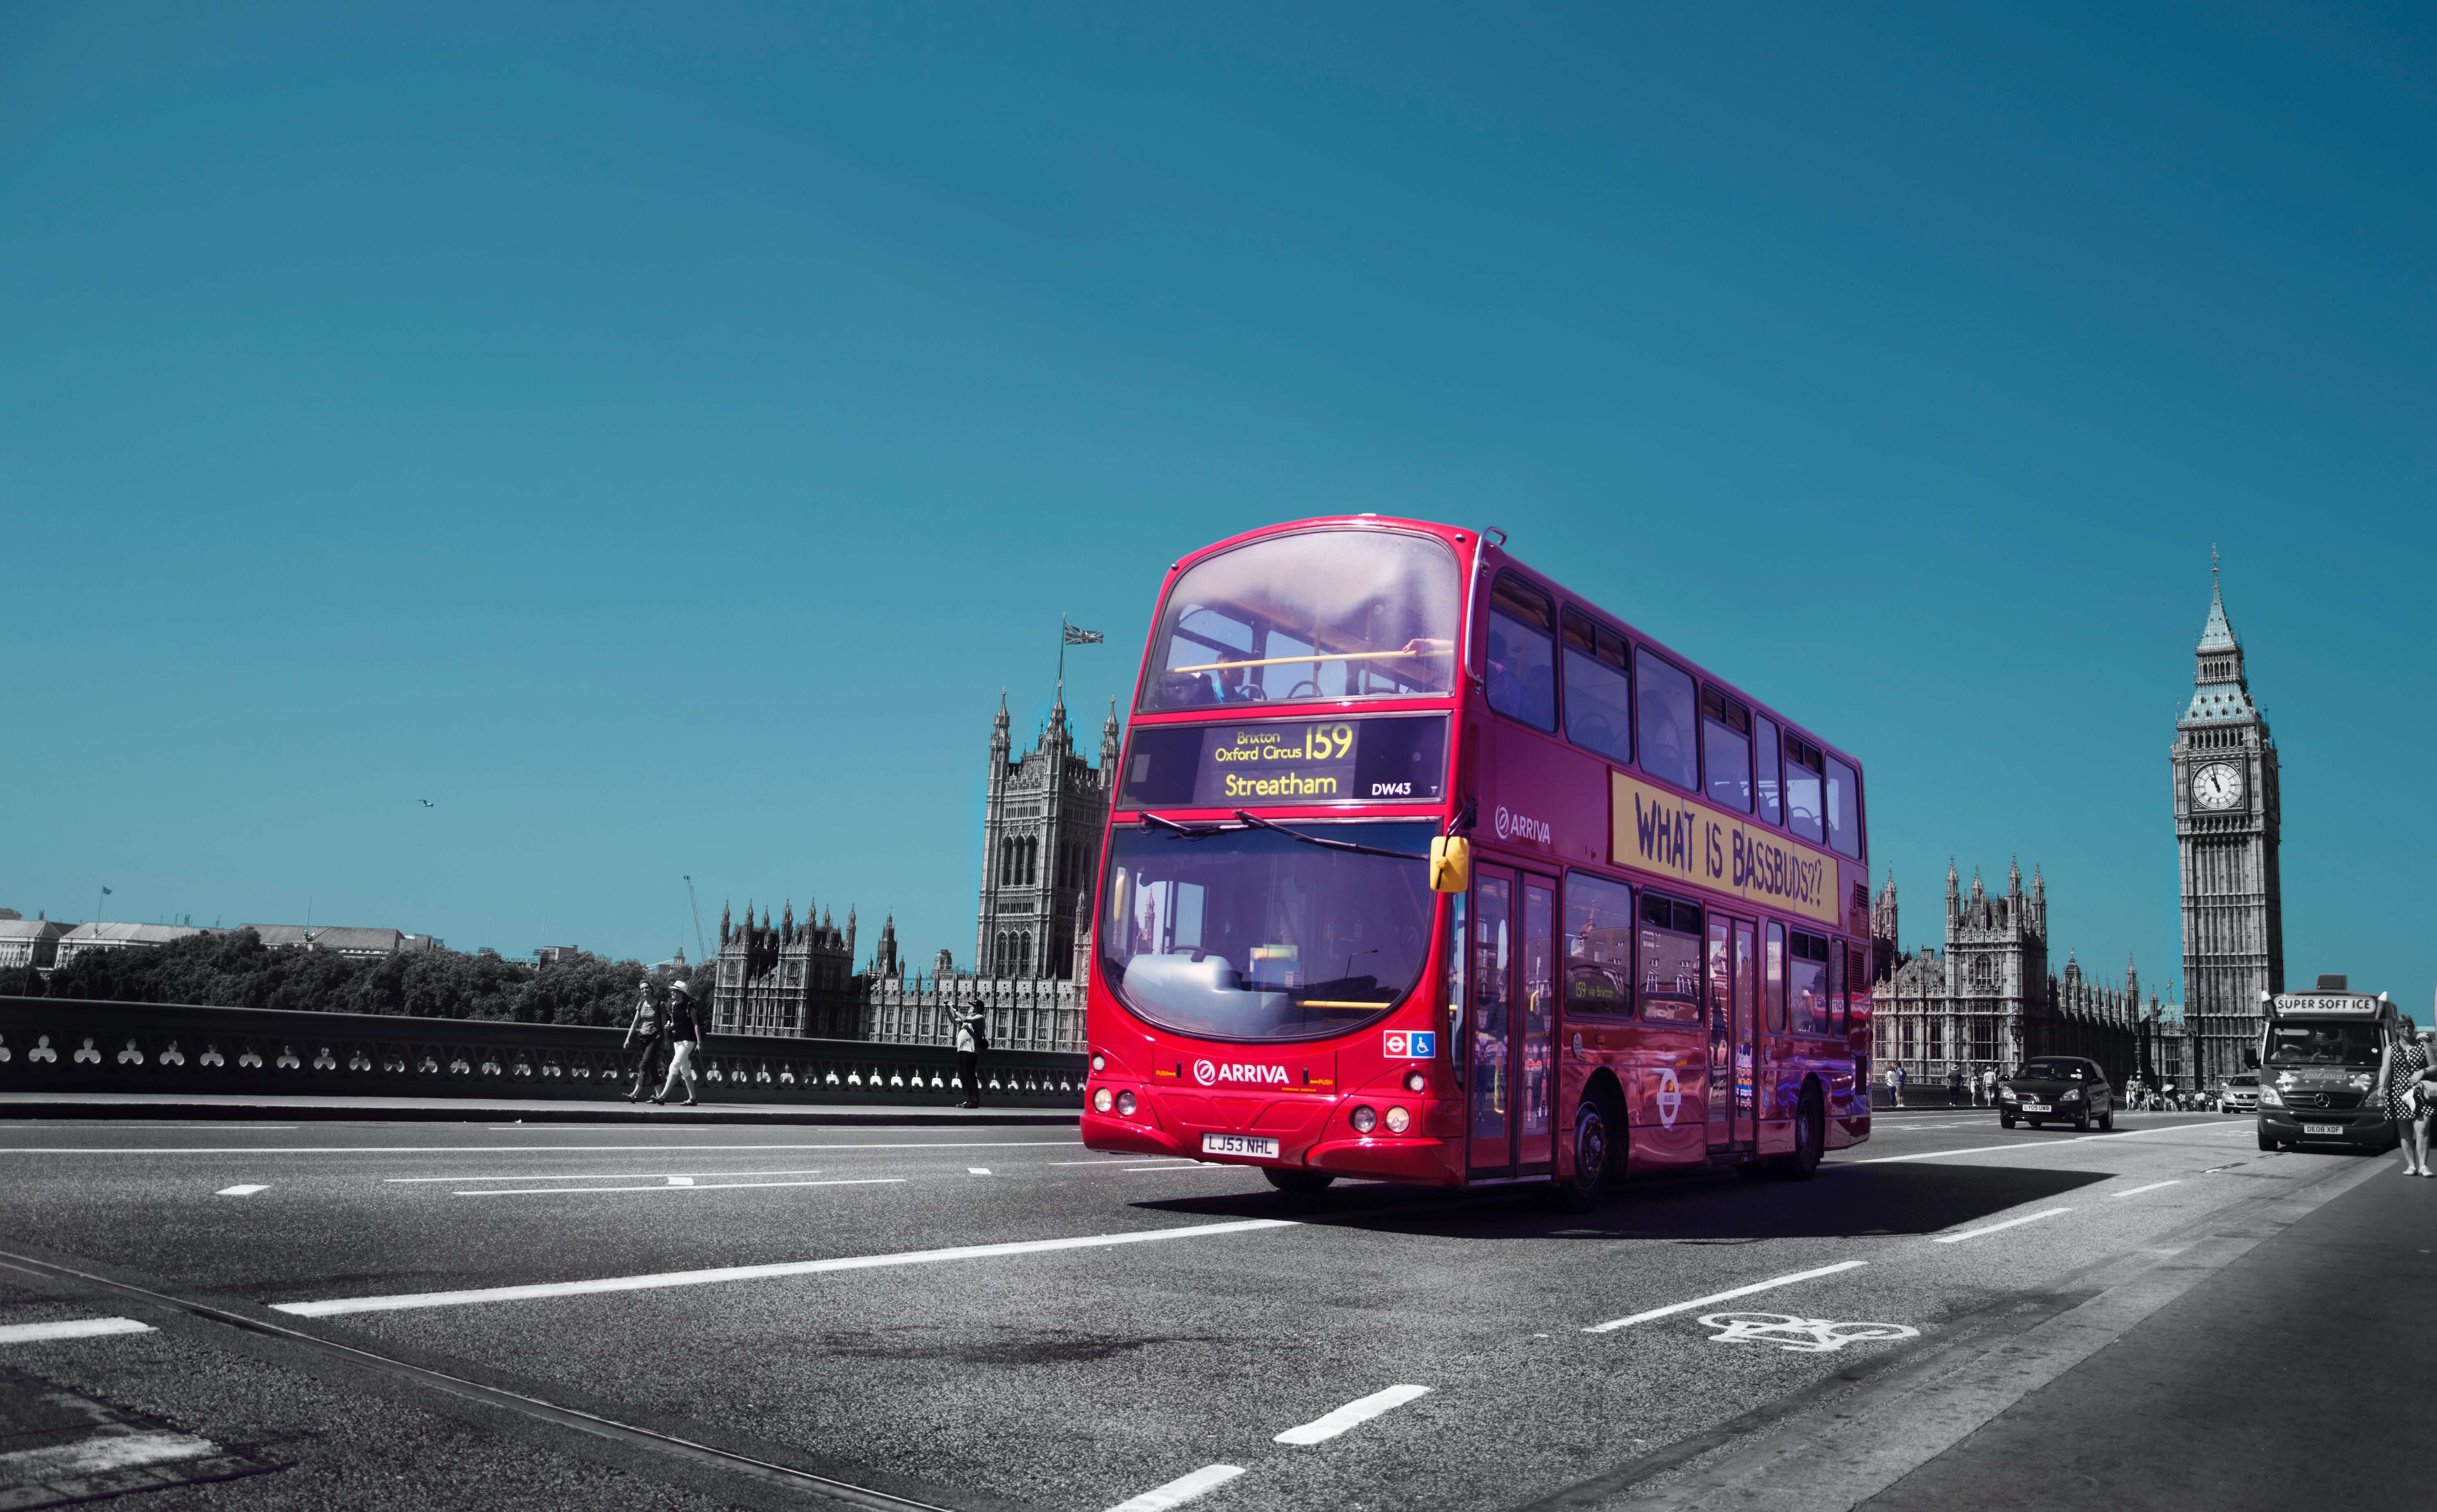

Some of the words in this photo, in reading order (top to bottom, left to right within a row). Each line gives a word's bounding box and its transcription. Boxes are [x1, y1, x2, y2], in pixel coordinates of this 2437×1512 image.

[1237, 731, 1280, 745] Brixton
[1306, 723, 1353, 760] 159
[1215, 747, 1258, 762] Oxford
[1263, 745, 1302, 760] Circus
[1225, 772, 1337, 797] Streatham
[1372, 783, 1411, 795] DW43
[1510, 814, 1551, 844] ARRIVA
[1635, 792, 1695, 874] WHAT
[1706, 820, 1722, 879] IS
[1733, 828, 1822, 908] BASSBUDS??
[1576, 981, 1586, 998] 159
[1597, 985, 1613, 998] Brixton
[2278, 999, 2315, 1009] SUPER
[2318, 999, 2348, 1009] SOFT
[2352, 999, 2370, 1010] ICE
[1218, 1064, 1290, 1084] ARRIVA
[1208, 1136, 1244, 1152] LJ53
[1247, 1138, 1272, 1154] NHL
